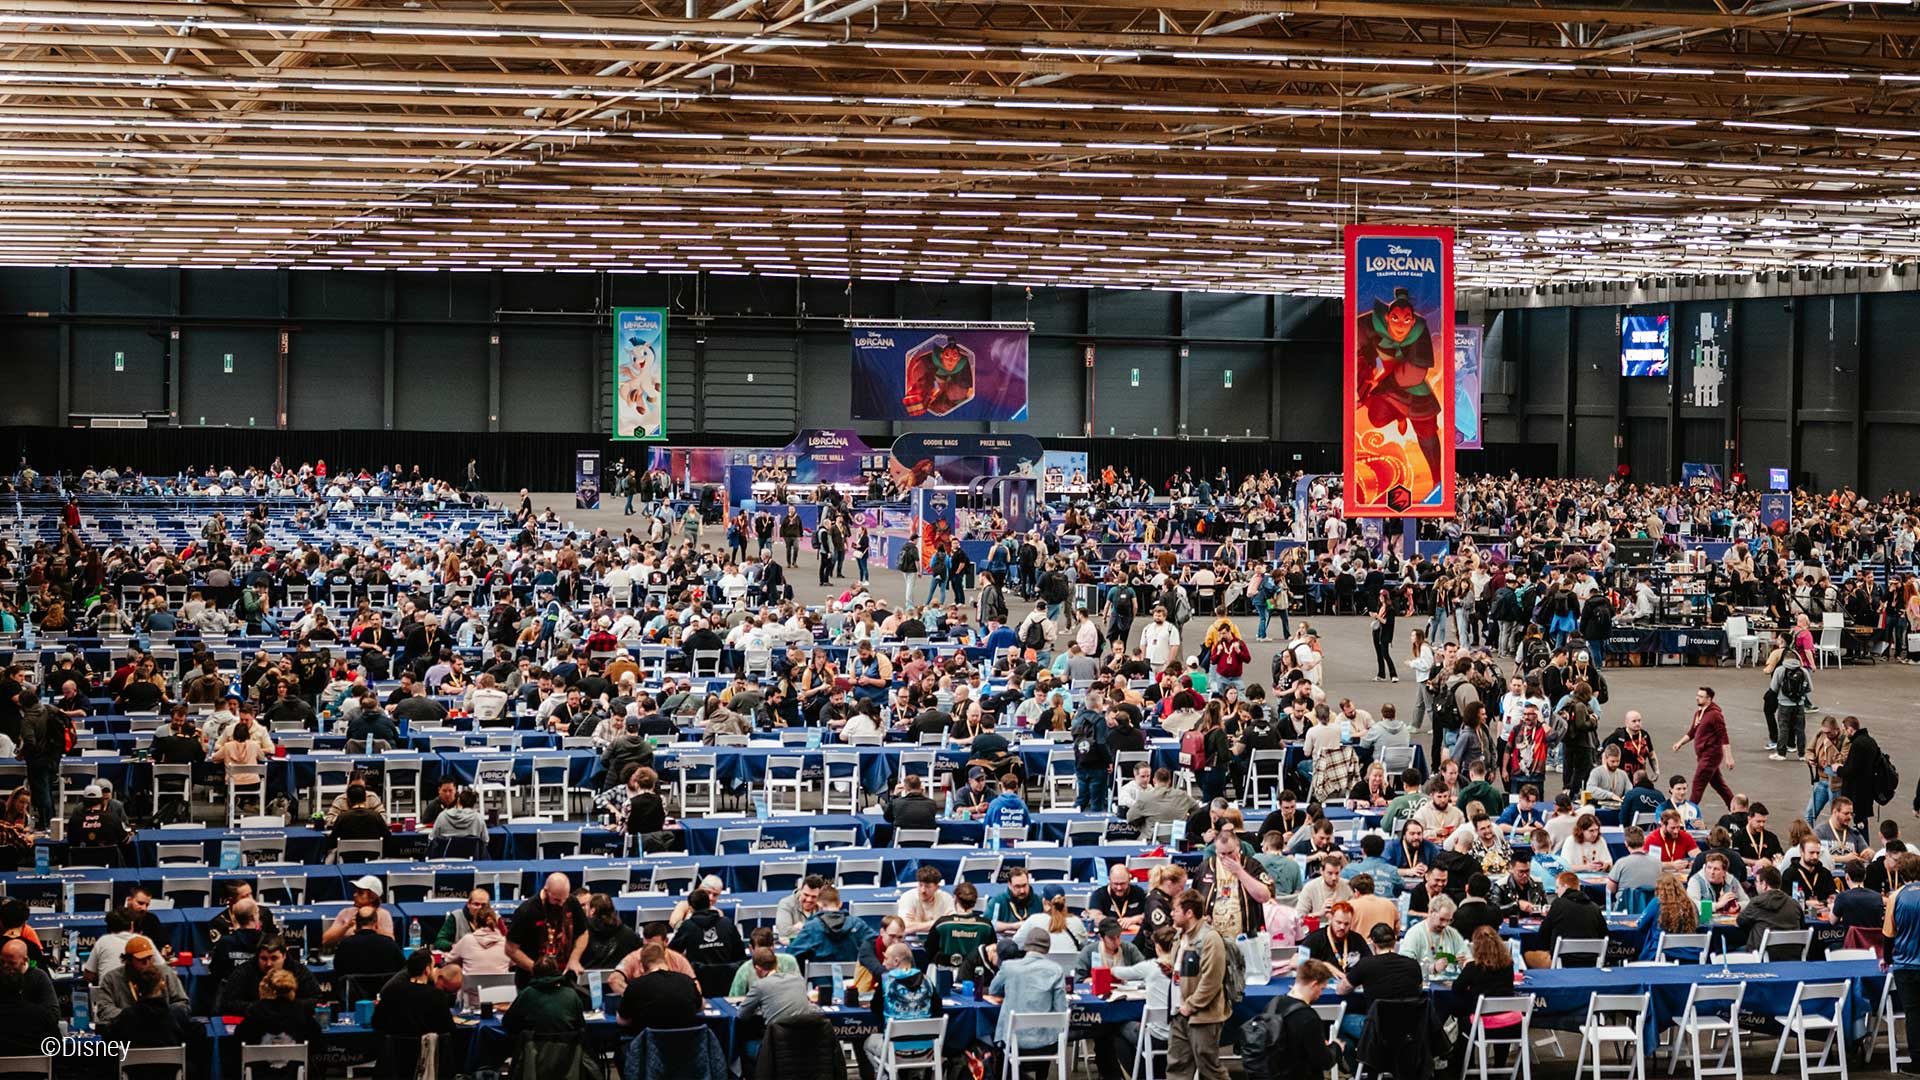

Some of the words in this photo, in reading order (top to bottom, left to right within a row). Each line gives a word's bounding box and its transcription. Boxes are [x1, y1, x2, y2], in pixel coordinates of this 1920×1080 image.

[1387, 244, 1412, 257] Disney
[1366, 257, 1436, 273] LORCANA
[855, 338, 895, 347] LORCANA
[746, 373, 754, 382] 8
[808, 437, 848, 446] LORCANA
[979, 439, 996, 447] PRIZE
[1690, 477, 1714, 487] LORCANA
